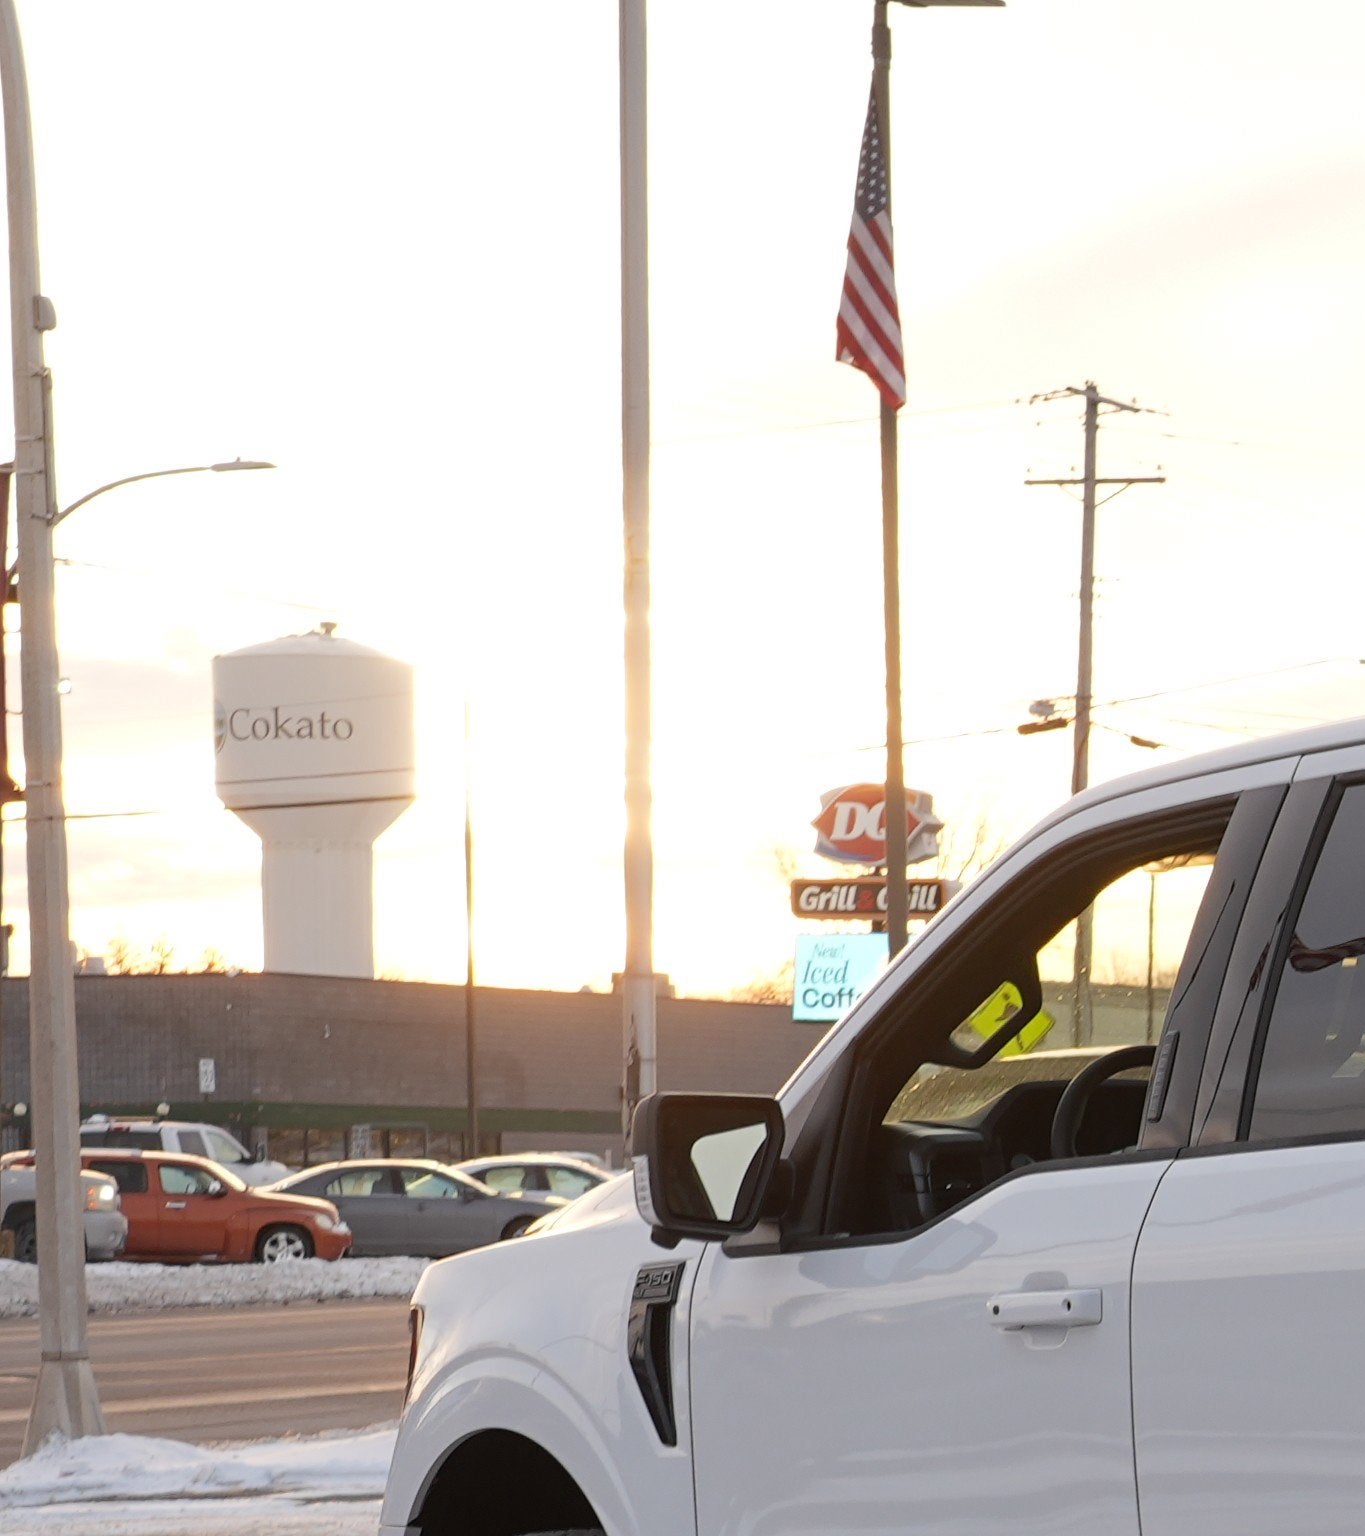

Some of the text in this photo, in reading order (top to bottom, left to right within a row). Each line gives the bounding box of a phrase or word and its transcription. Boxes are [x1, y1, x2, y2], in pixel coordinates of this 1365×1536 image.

[229, 706, 354, 741] Cokato
[799, 884, 858, 912] Grill
[876, 884, 938, 912] Cill
[802, 959, 850, 984] Iced
[802, 987, 863, 1008] Coff
